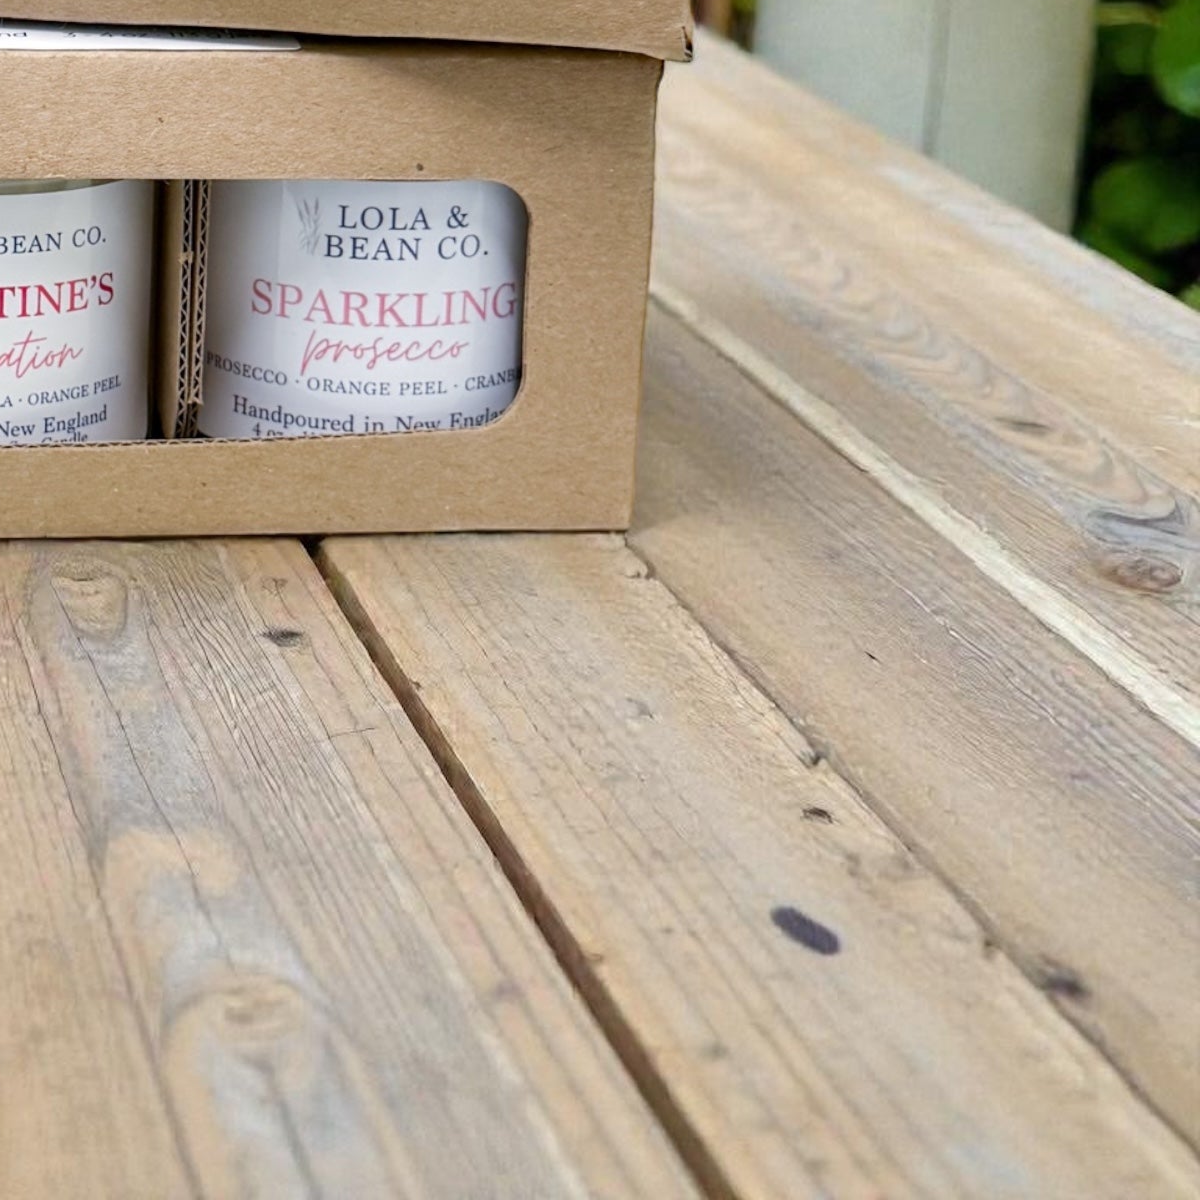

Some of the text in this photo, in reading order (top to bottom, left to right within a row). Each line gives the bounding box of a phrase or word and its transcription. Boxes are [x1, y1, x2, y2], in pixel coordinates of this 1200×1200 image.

[338, 204, 469, 231] LOLA &
[72, 225, 106, 248] CO.
[324, 234, 488, 261] BEAN CO.
[251, 278, 517, 327] SPARKLING
[300, 329, 469, 376] prosecco
[27, 383, 89, 407] ORANGE
[93, 374, 122, 395] PEEL
[206, 352, 288, 386] PROSECCO
[307, 377, 391, 396] ORANGE
[399, 380, 447, 396] PEEL
[43, 404, 108, 434] England
[232, 394, 354, 433] Handpoured
[365, 415, 384, 432] in
[396, 415, 441, 430] New
